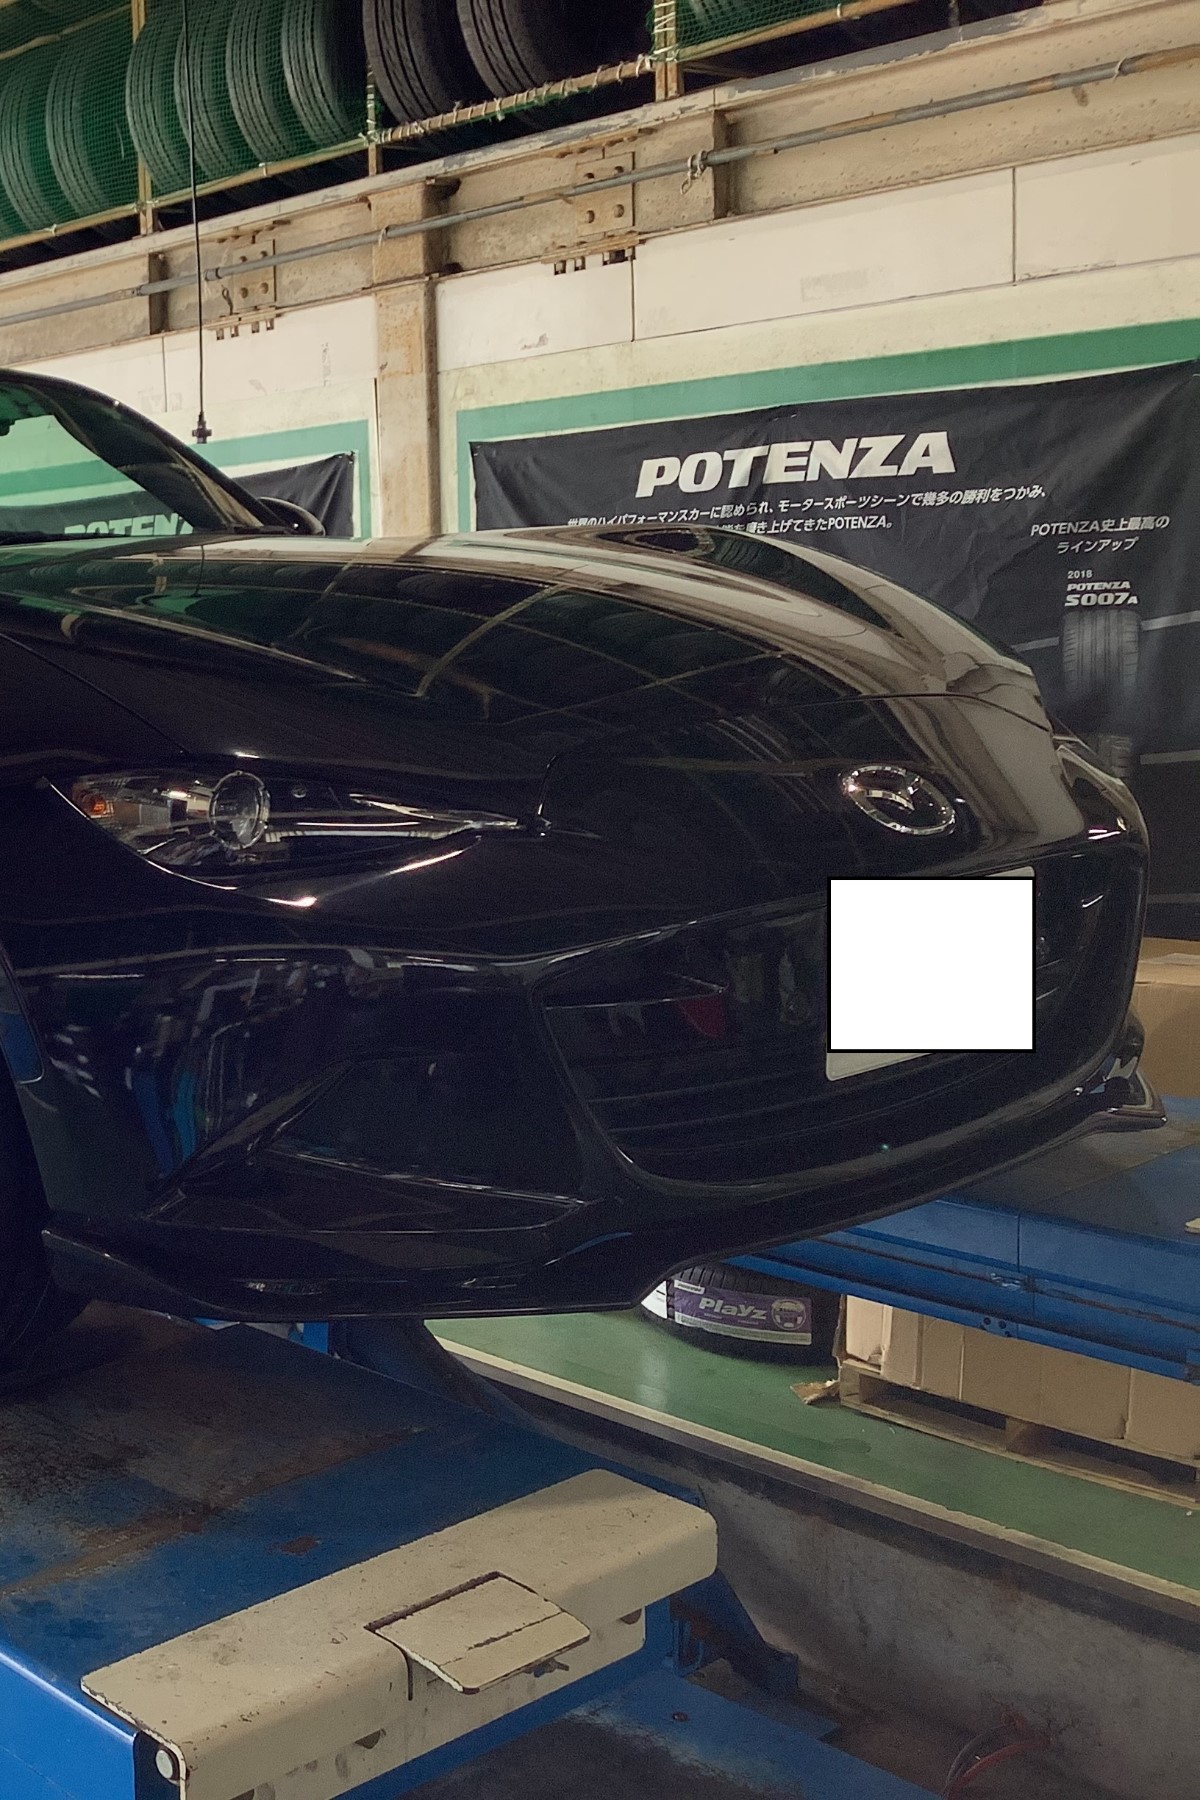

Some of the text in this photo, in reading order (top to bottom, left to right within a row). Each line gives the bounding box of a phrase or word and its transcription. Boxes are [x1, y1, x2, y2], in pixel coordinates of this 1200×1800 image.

[635, 431, 956, 498] POTENZA
[1030, 515, 1170, 537] POTENZA史上最高の
[1057, 536, 1139, 555] ラインアップ
[1067, 569, 1093, 579] 2018
[1067, 581, 1131, 592] POTENZA
